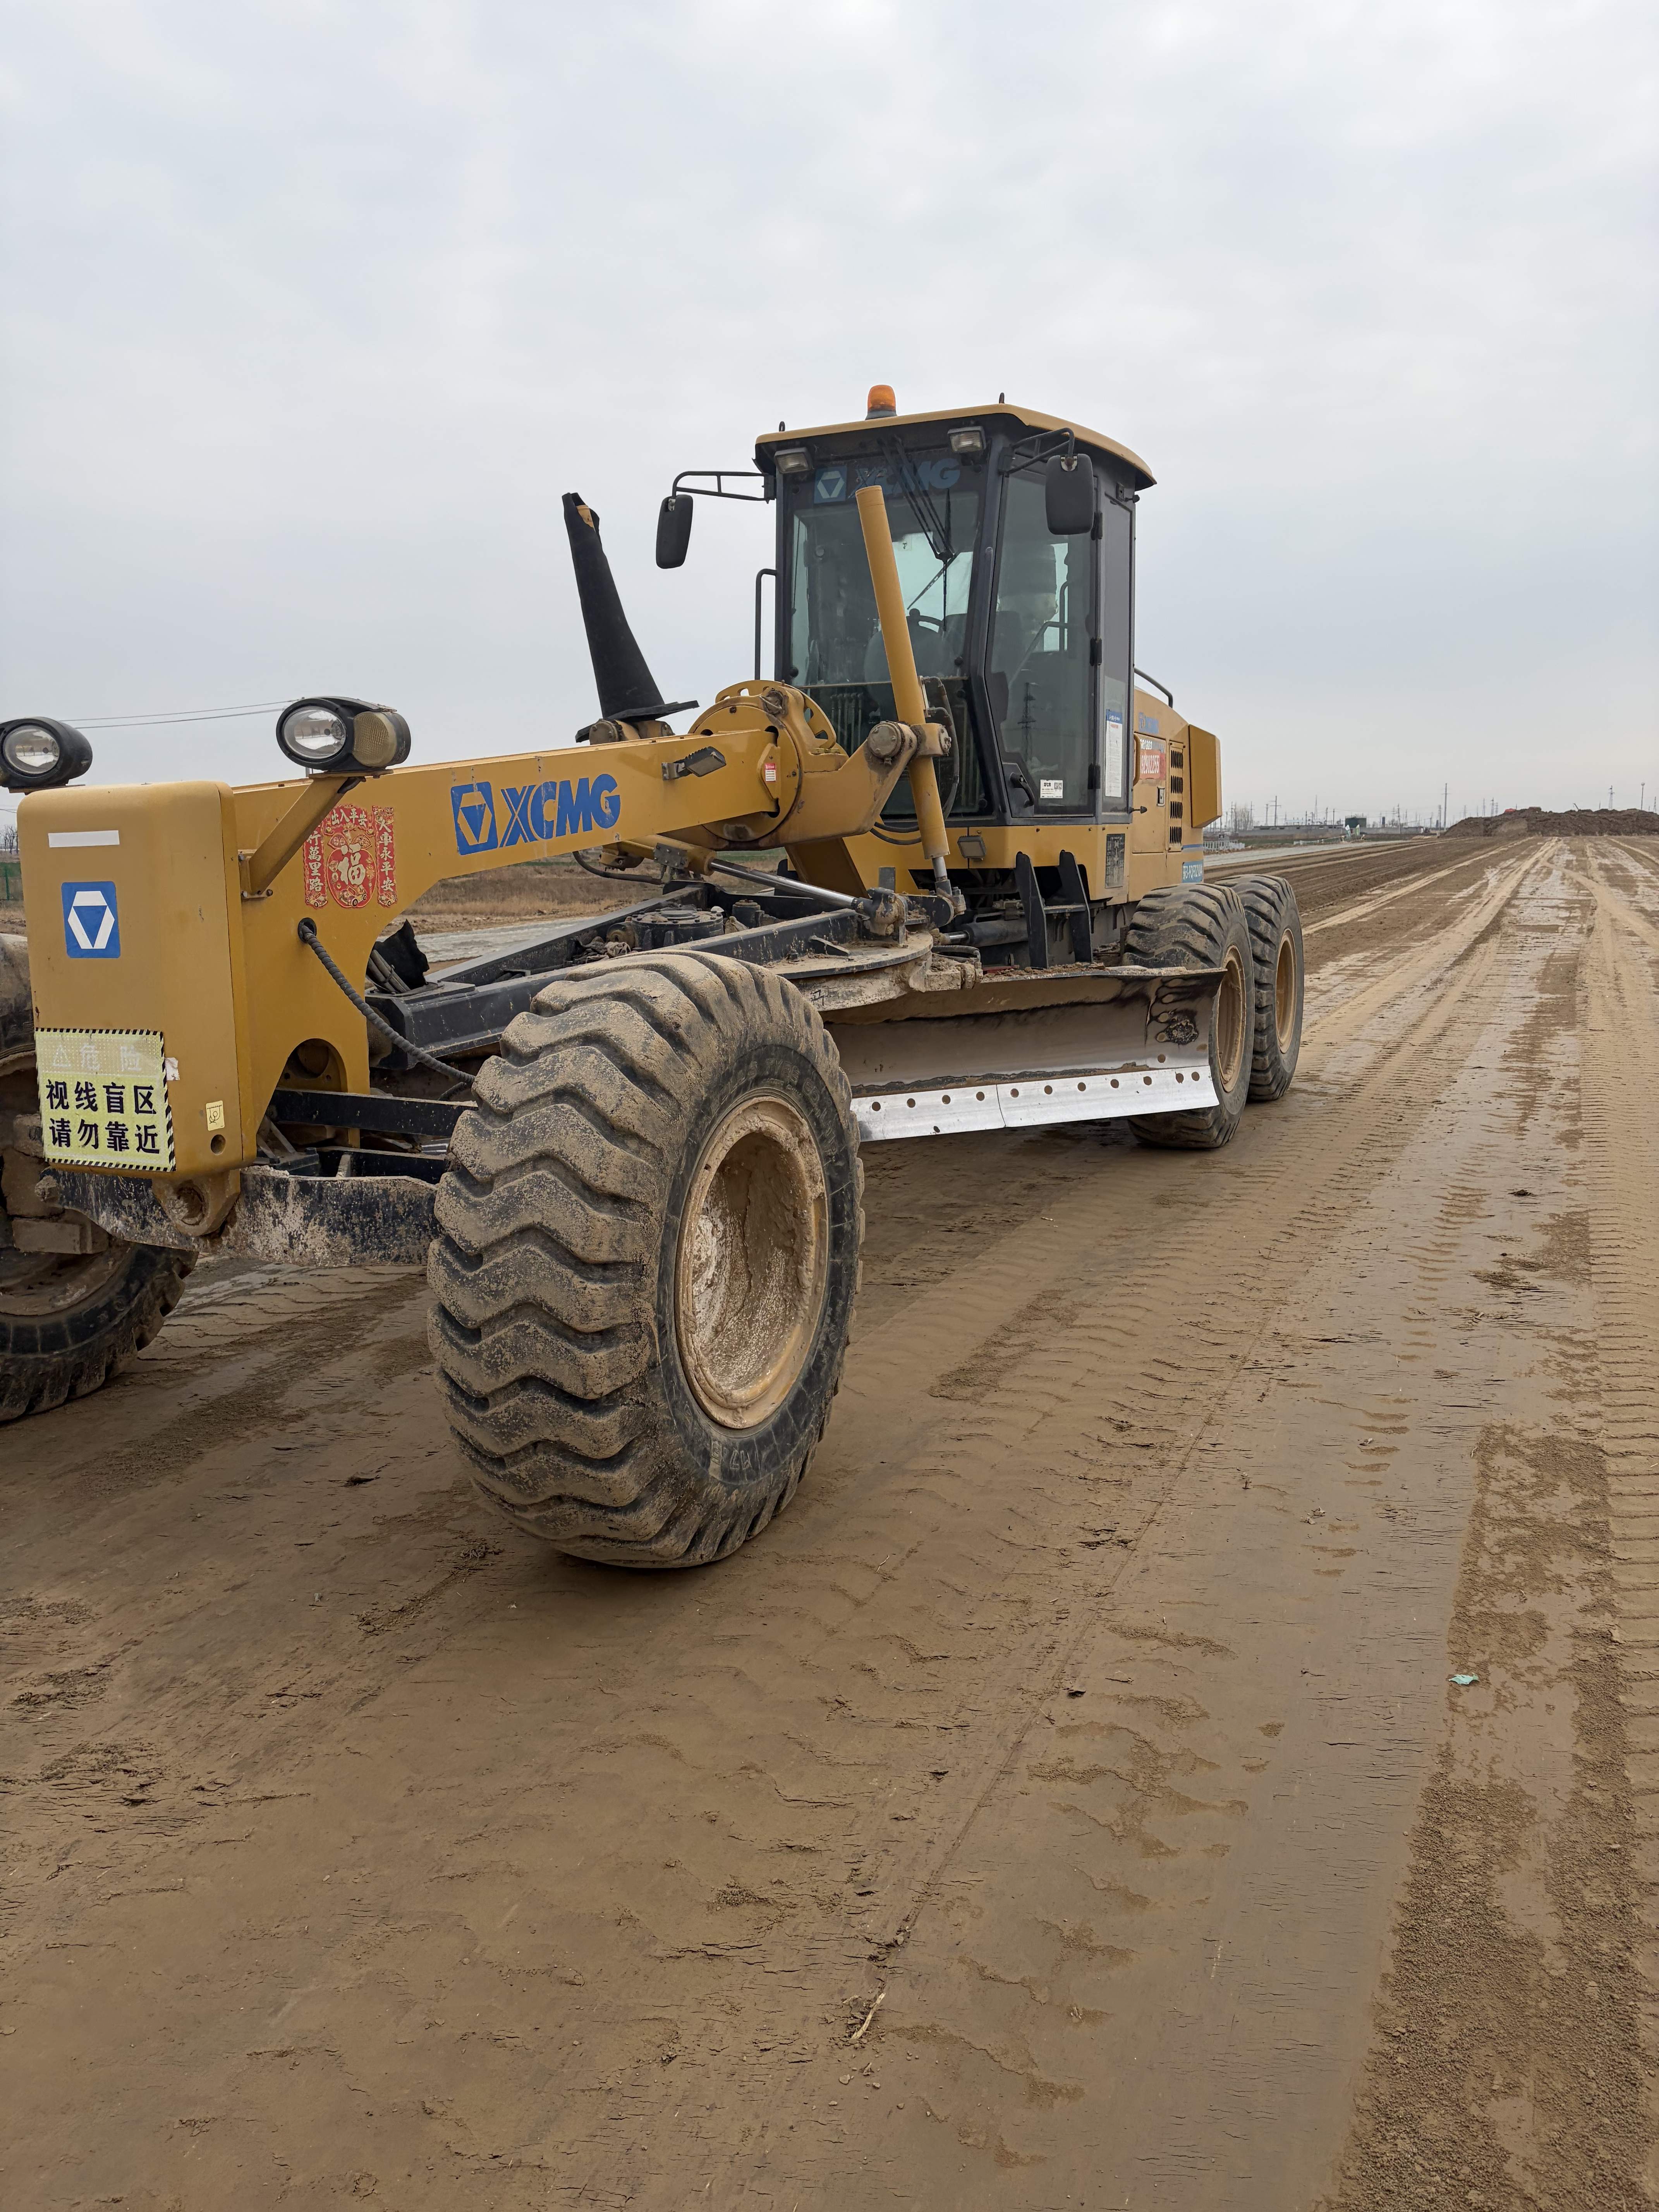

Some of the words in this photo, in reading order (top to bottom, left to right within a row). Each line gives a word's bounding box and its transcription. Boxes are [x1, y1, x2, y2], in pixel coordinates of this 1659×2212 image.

[331, 808, 368, 827] 出入平安
[499, 774, 620, 848] XCMG
[307, 825, 323, 892] 行萬里路
[337, 843, 366, 885] 福
[379, 819, 395, 891] 人車永平安
[45, 1079, 156, 1114] 视线盲区
[49, 1118, 160, 1154] 请勿靠近
